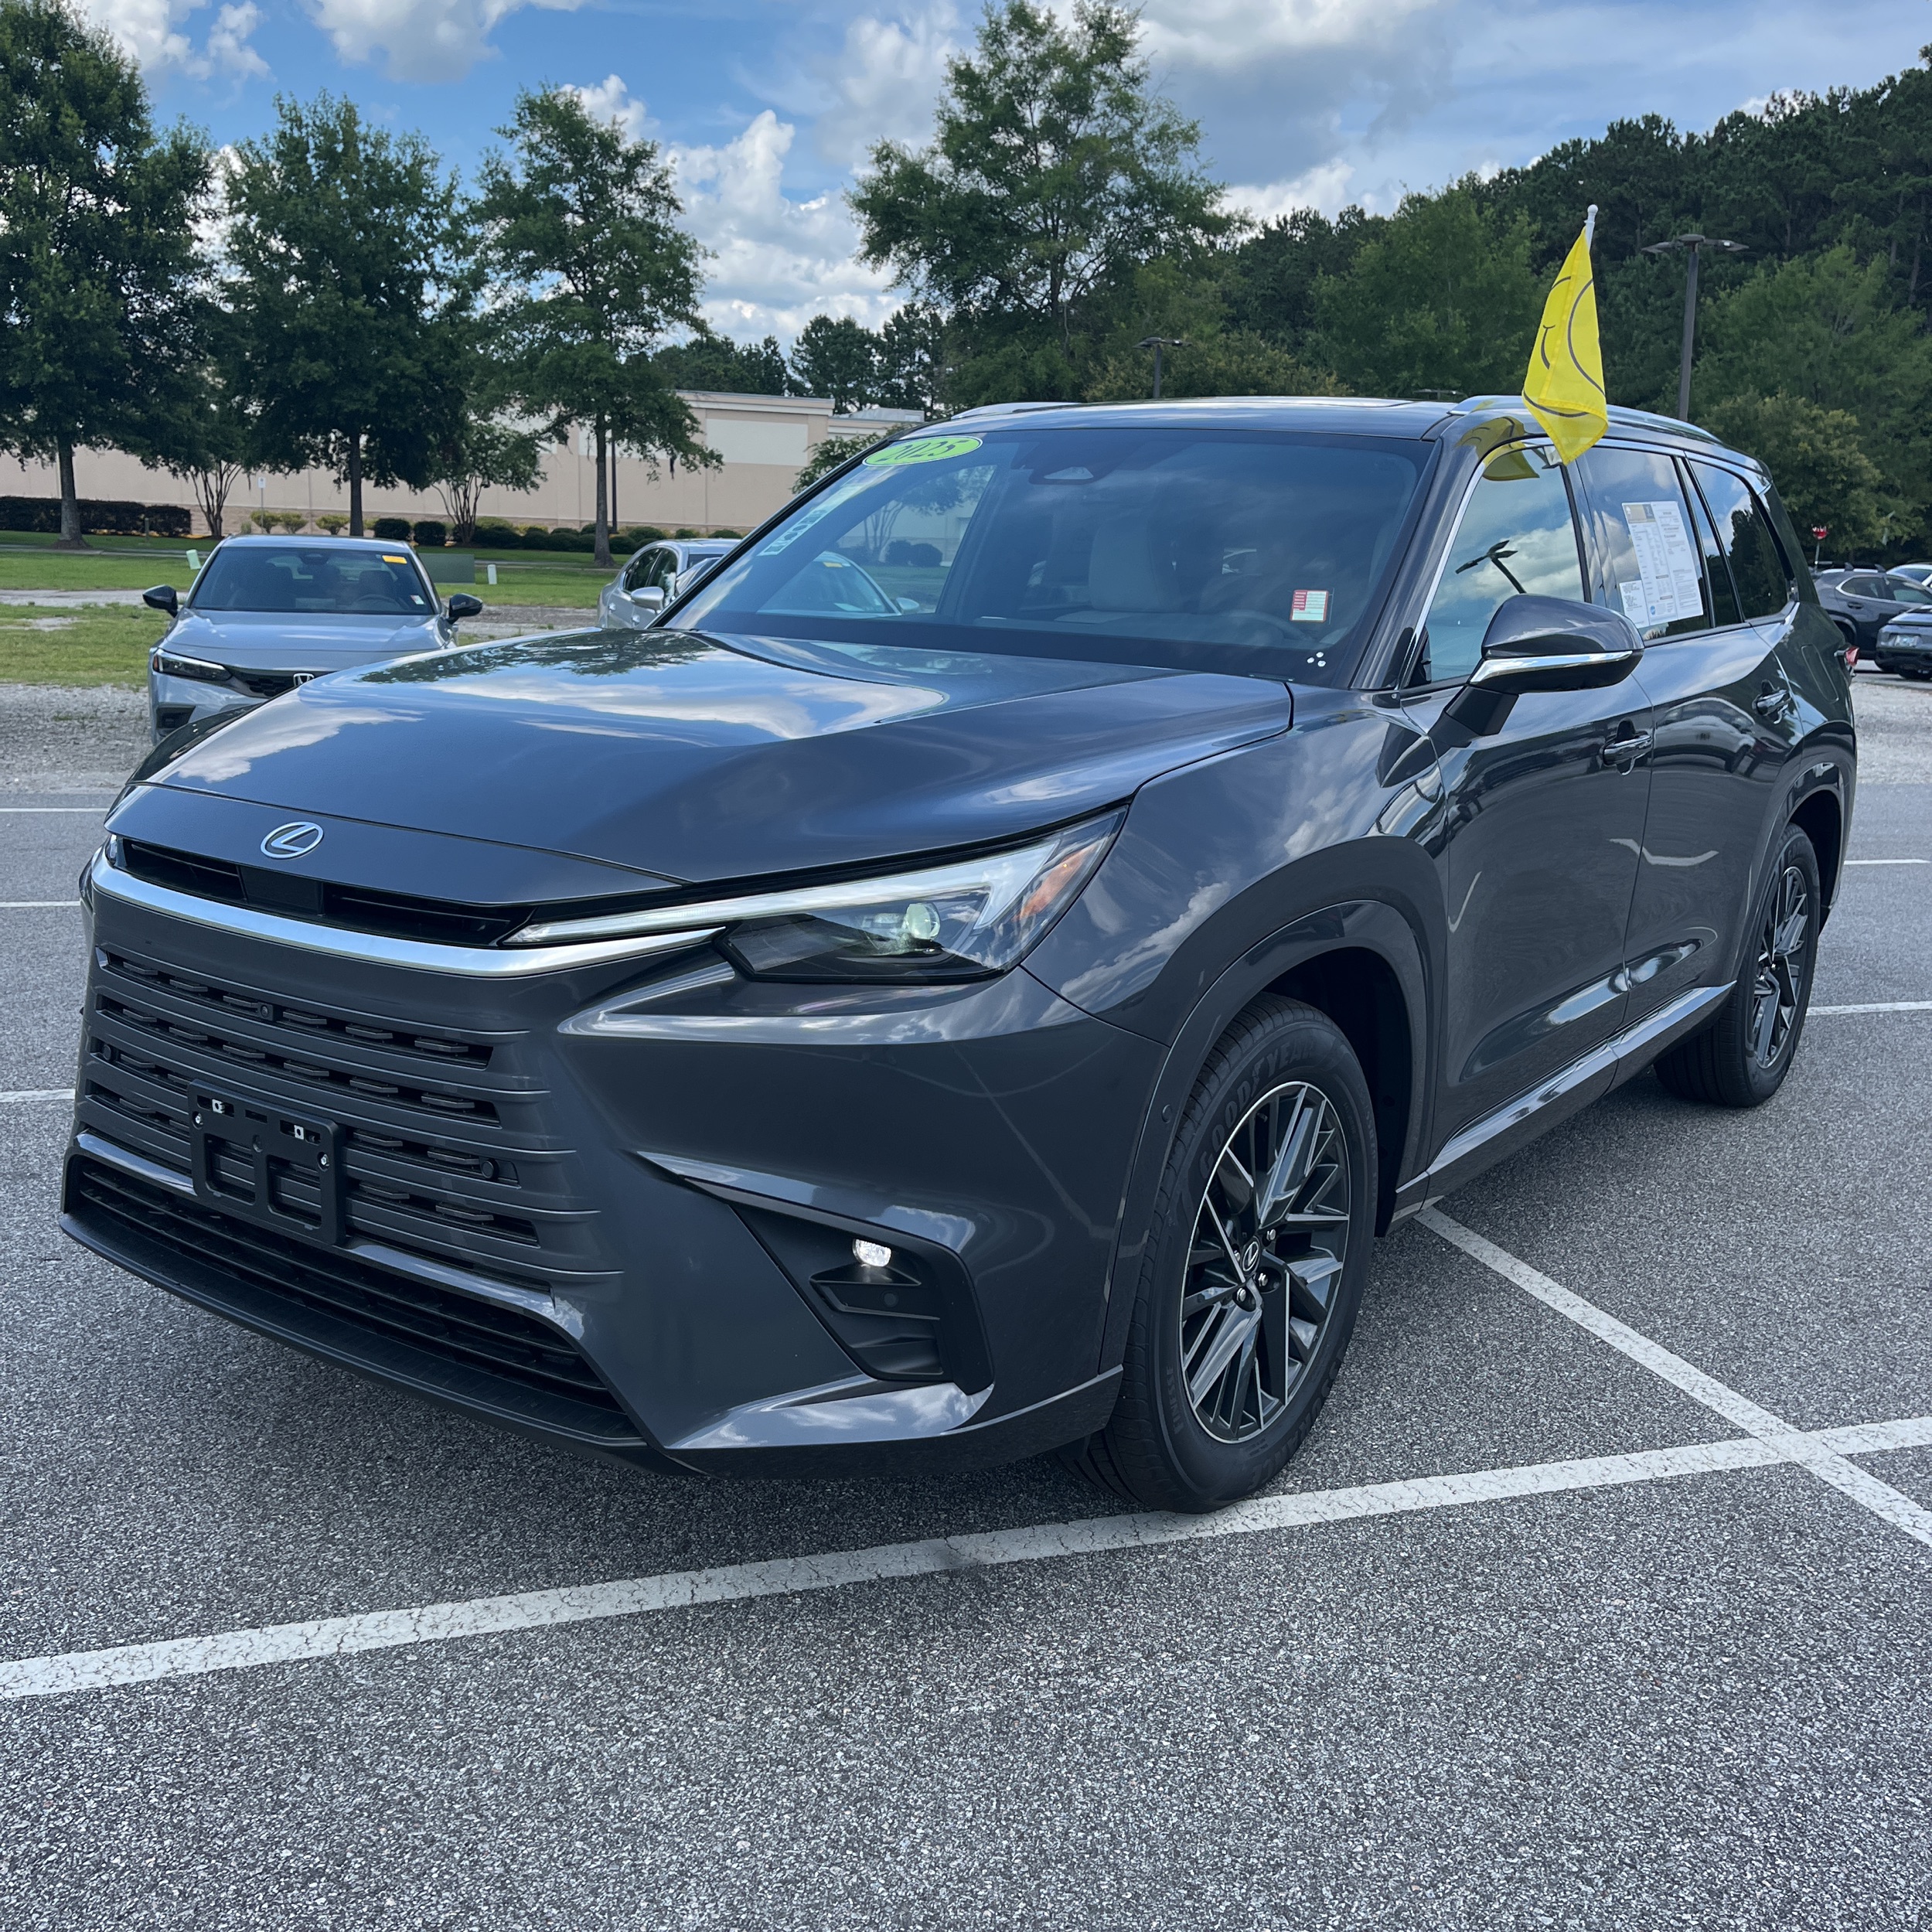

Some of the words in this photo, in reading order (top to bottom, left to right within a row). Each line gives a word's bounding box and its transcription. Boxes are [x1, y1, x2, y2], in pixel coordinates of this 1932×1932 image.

[875, 439, 970, 462] 2025
[1198, 1039, 1316, 1179] GOODYEAR
[1166, 1365, 1184, 1435] FINESSE
